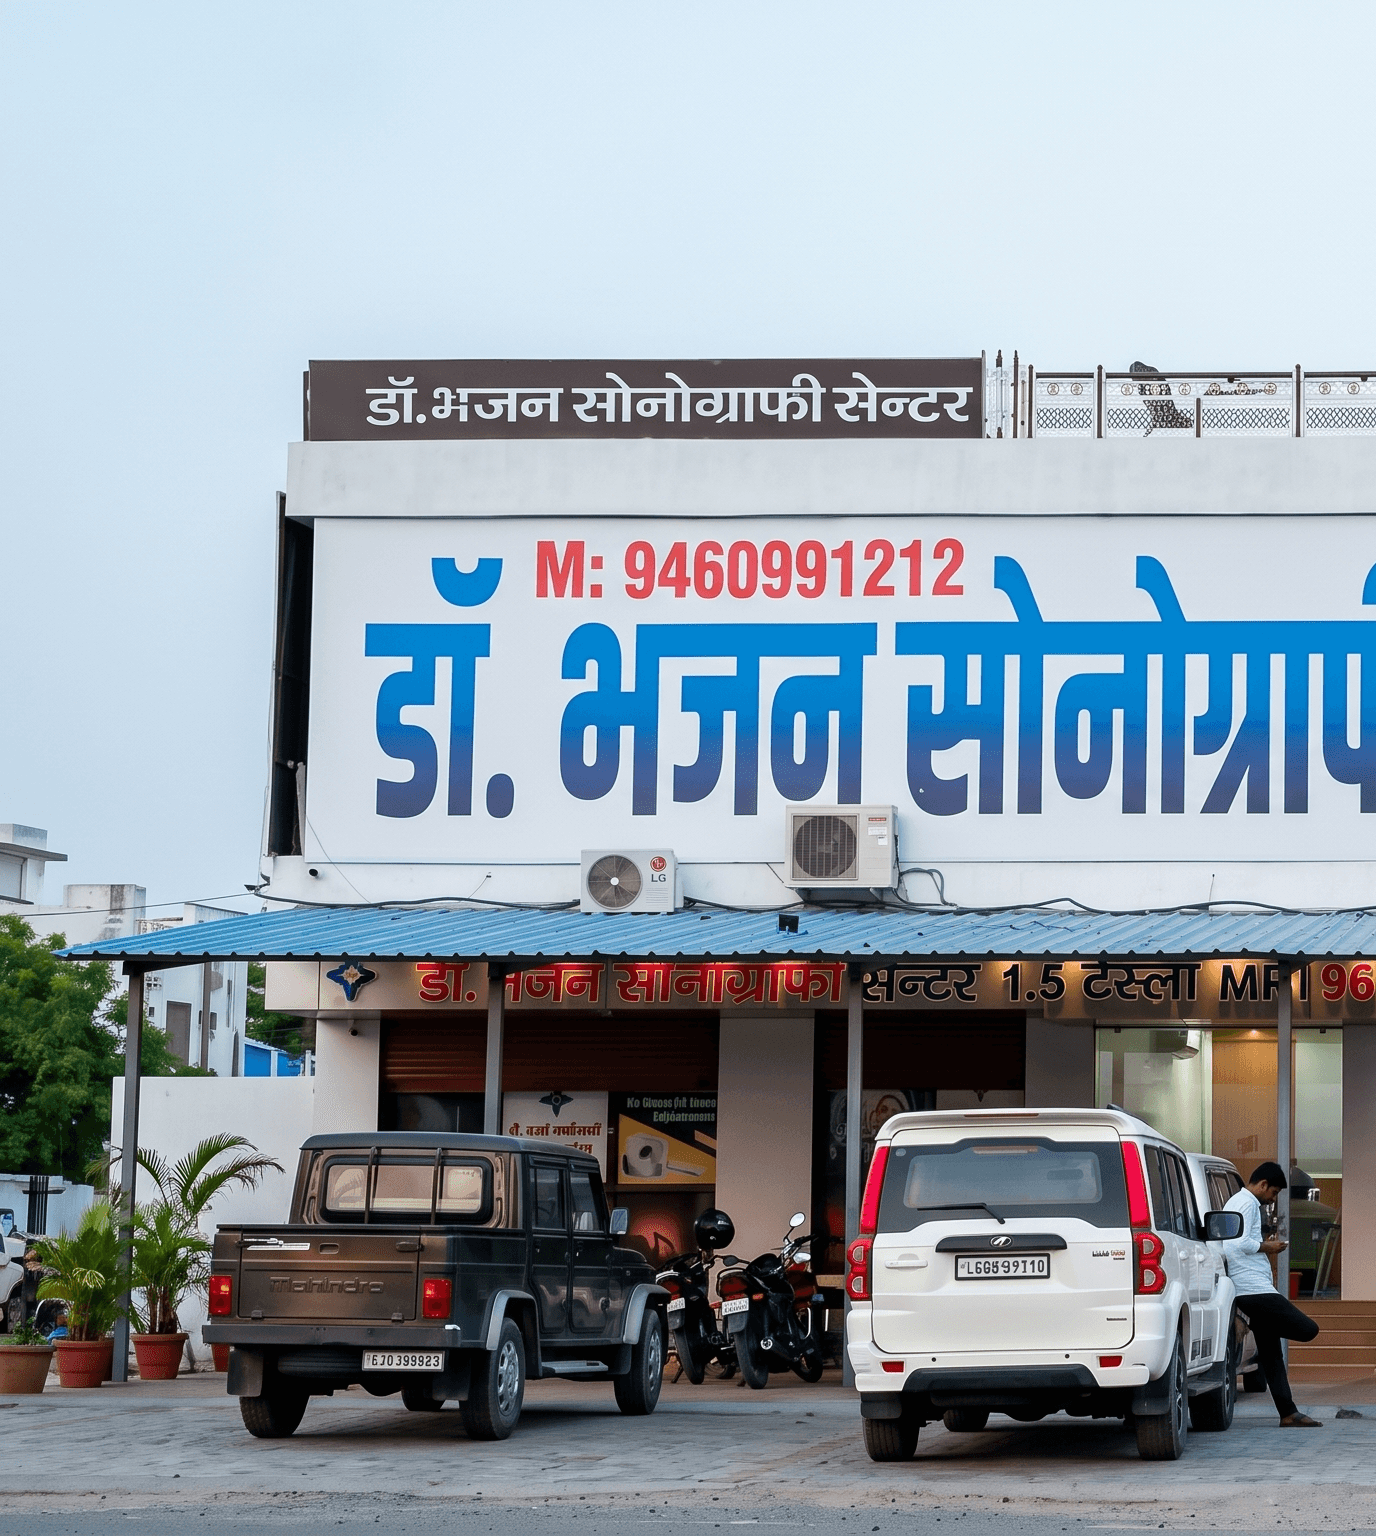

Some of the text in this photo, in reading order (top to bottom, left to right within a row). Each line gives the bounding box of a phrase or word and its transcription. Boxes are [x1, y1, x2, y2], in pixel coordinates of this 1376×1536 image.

[572, 373, 828, 425] सोनोग्राफी
[832, 372, 974, 424] सेन्टर
[536, 538, 965, 600] M: 9460991212
[364, 557, 515, 818] डॉ.
[560, 622, 878, 817] भजन
[650, 873, 667, 883] LG
[1002, 962, 1067, 1002] 1.5
[1320, 962, 1376, 1002] 96
